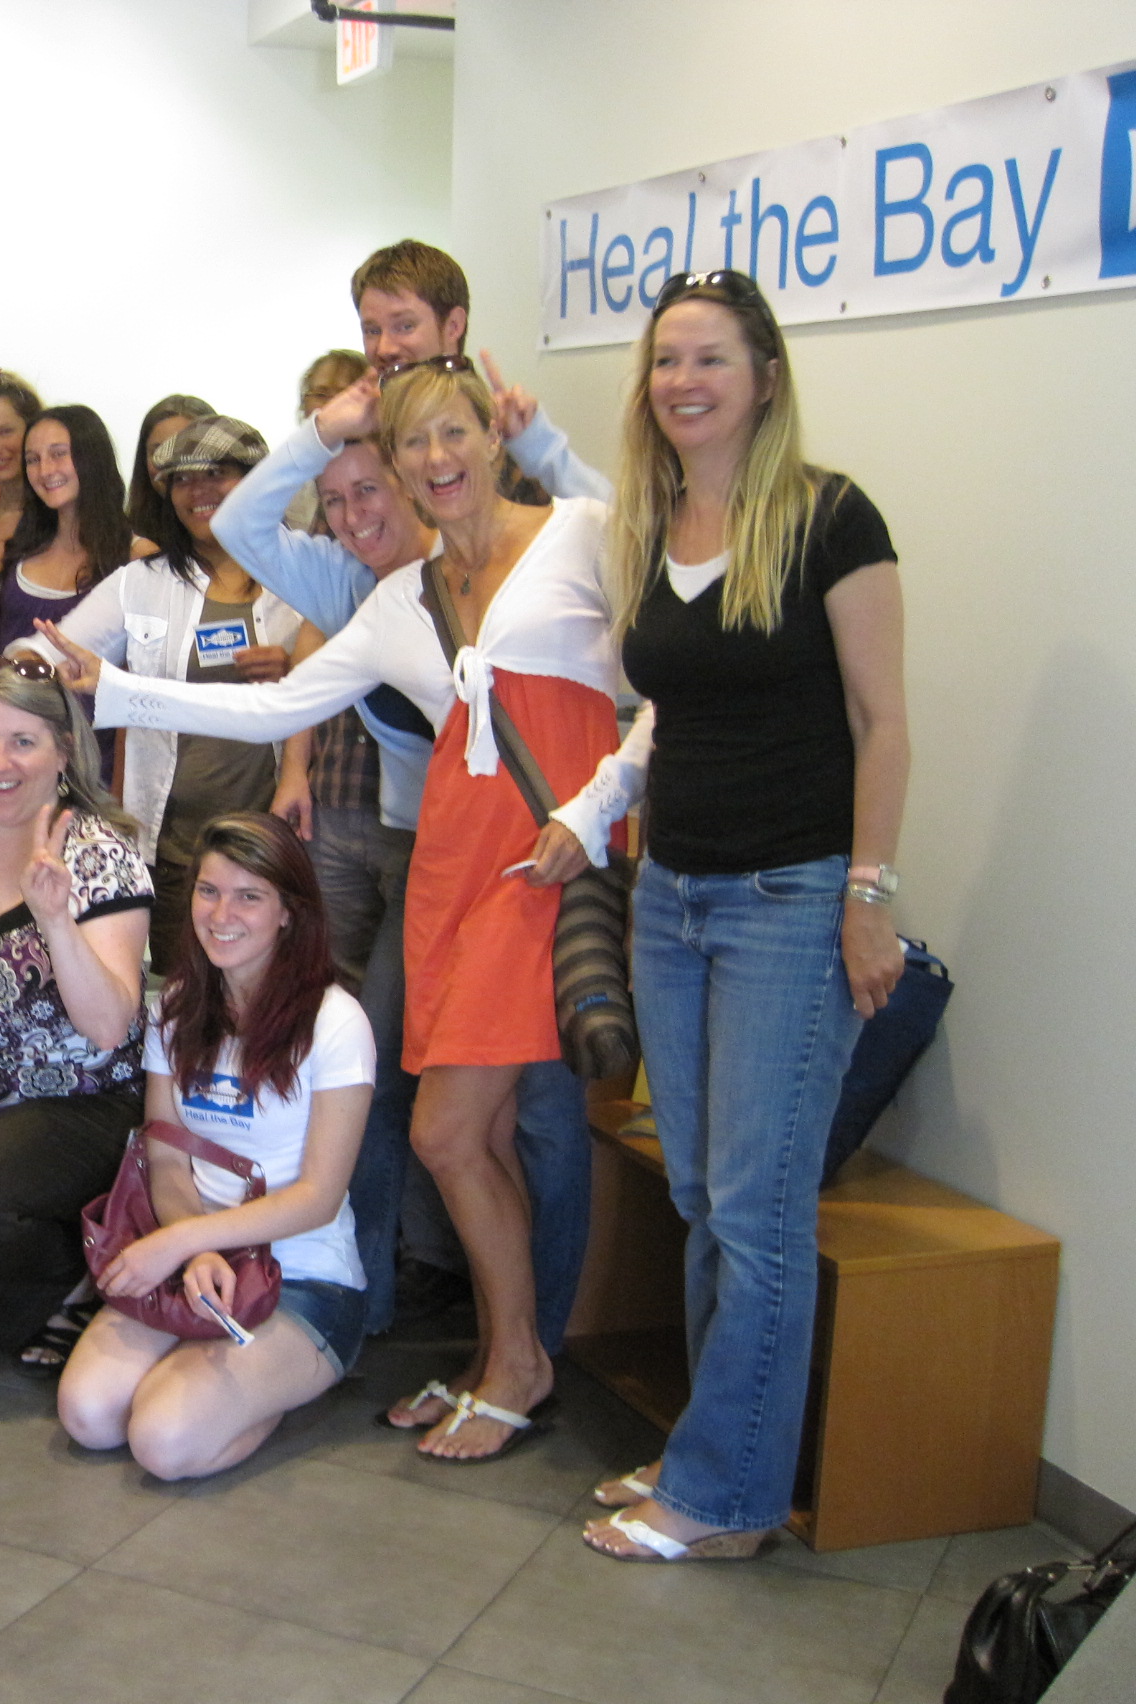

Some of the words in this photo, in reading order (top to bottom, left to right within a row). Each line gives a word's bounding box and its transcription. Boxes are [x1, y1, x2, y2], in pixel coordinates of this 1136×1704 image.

[560, 191, 697, 319] Heal
[720, 177, 839, 291] the
[874, 142, 1063, 297] Bay
[184, 1108, 208, 1121] Heal
[210, 1113, 228, 1125] the
[230, 1117, 251, 1131] Bay
